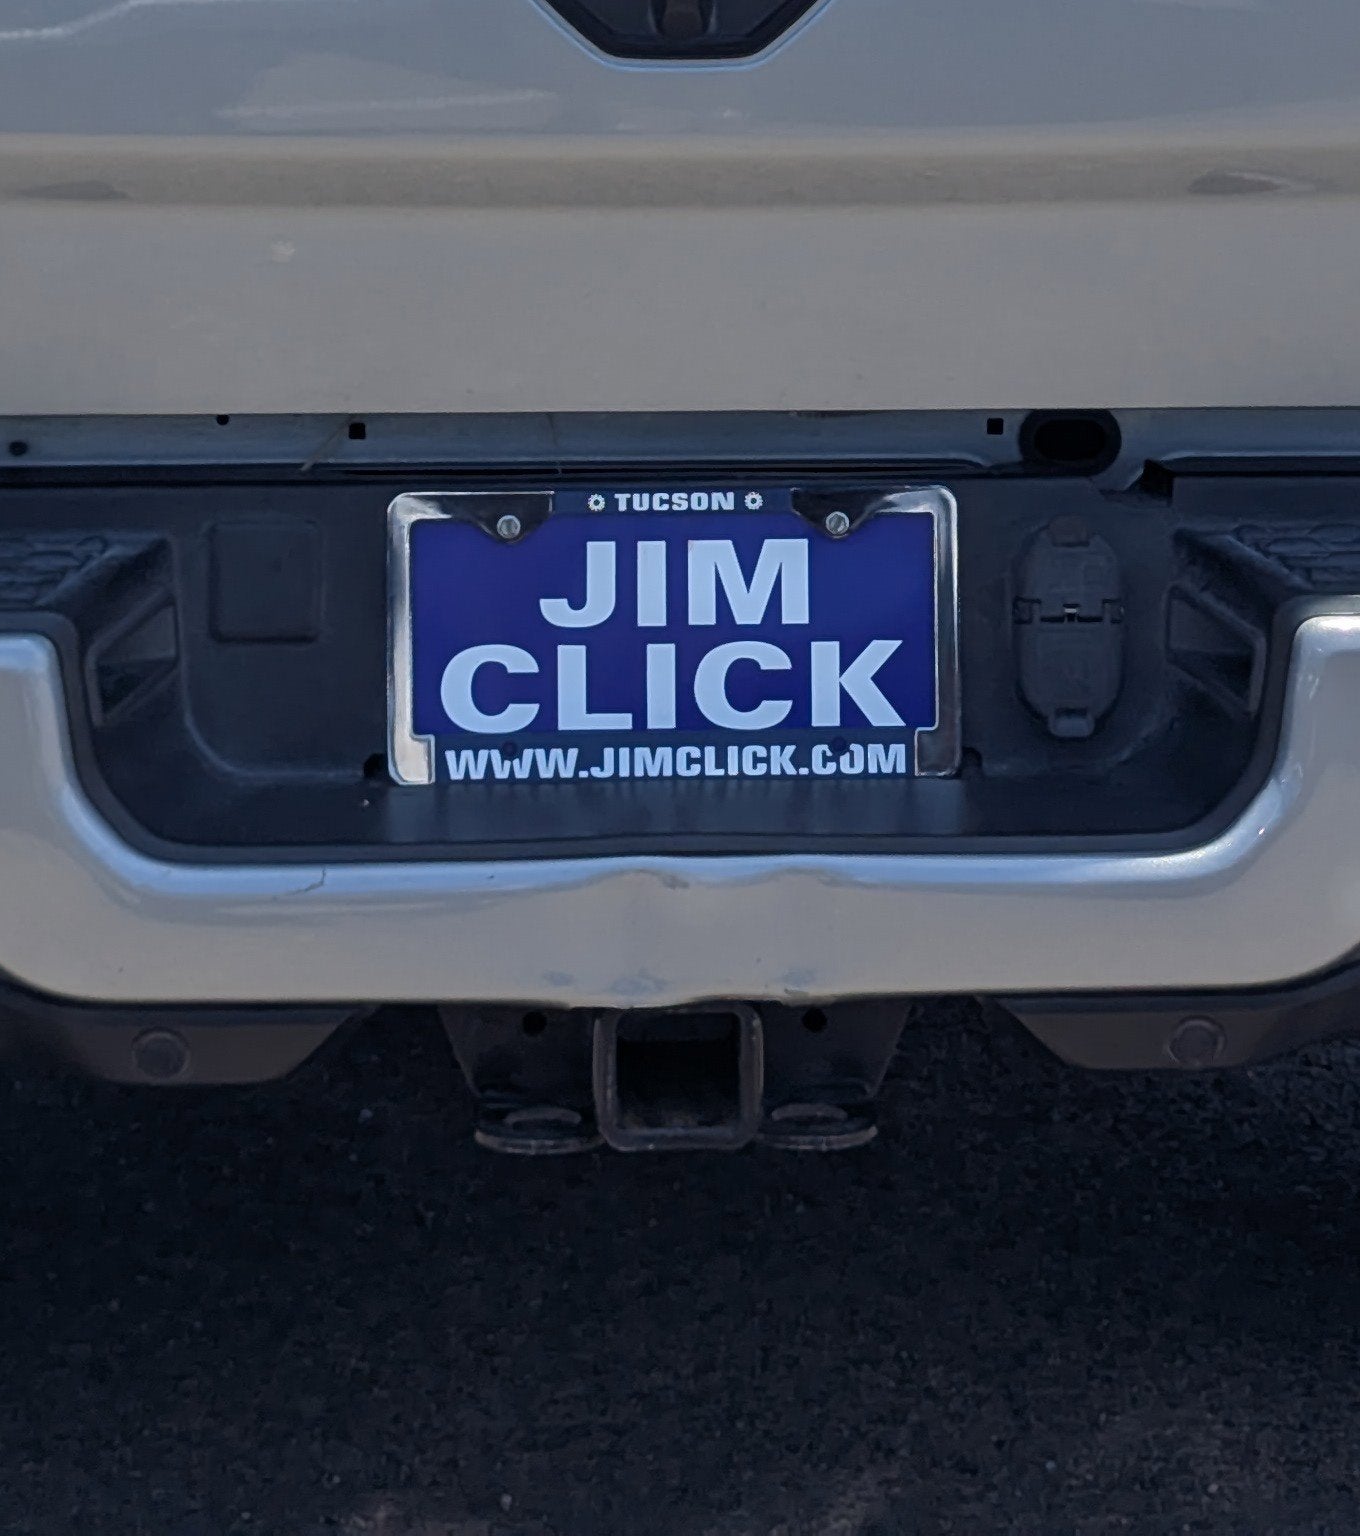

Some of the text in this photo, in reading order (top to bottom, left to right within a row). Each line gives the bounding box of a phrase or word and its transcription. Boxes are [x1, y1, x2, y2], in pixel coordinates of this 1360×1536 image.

[614, 492, 735, 512] TUCSON
[539, 538, 810, 628] JIM
[440, 639, 906, 733] CLICK
[445, 743, 907, 780] WWW.JIMCLICK.COM
